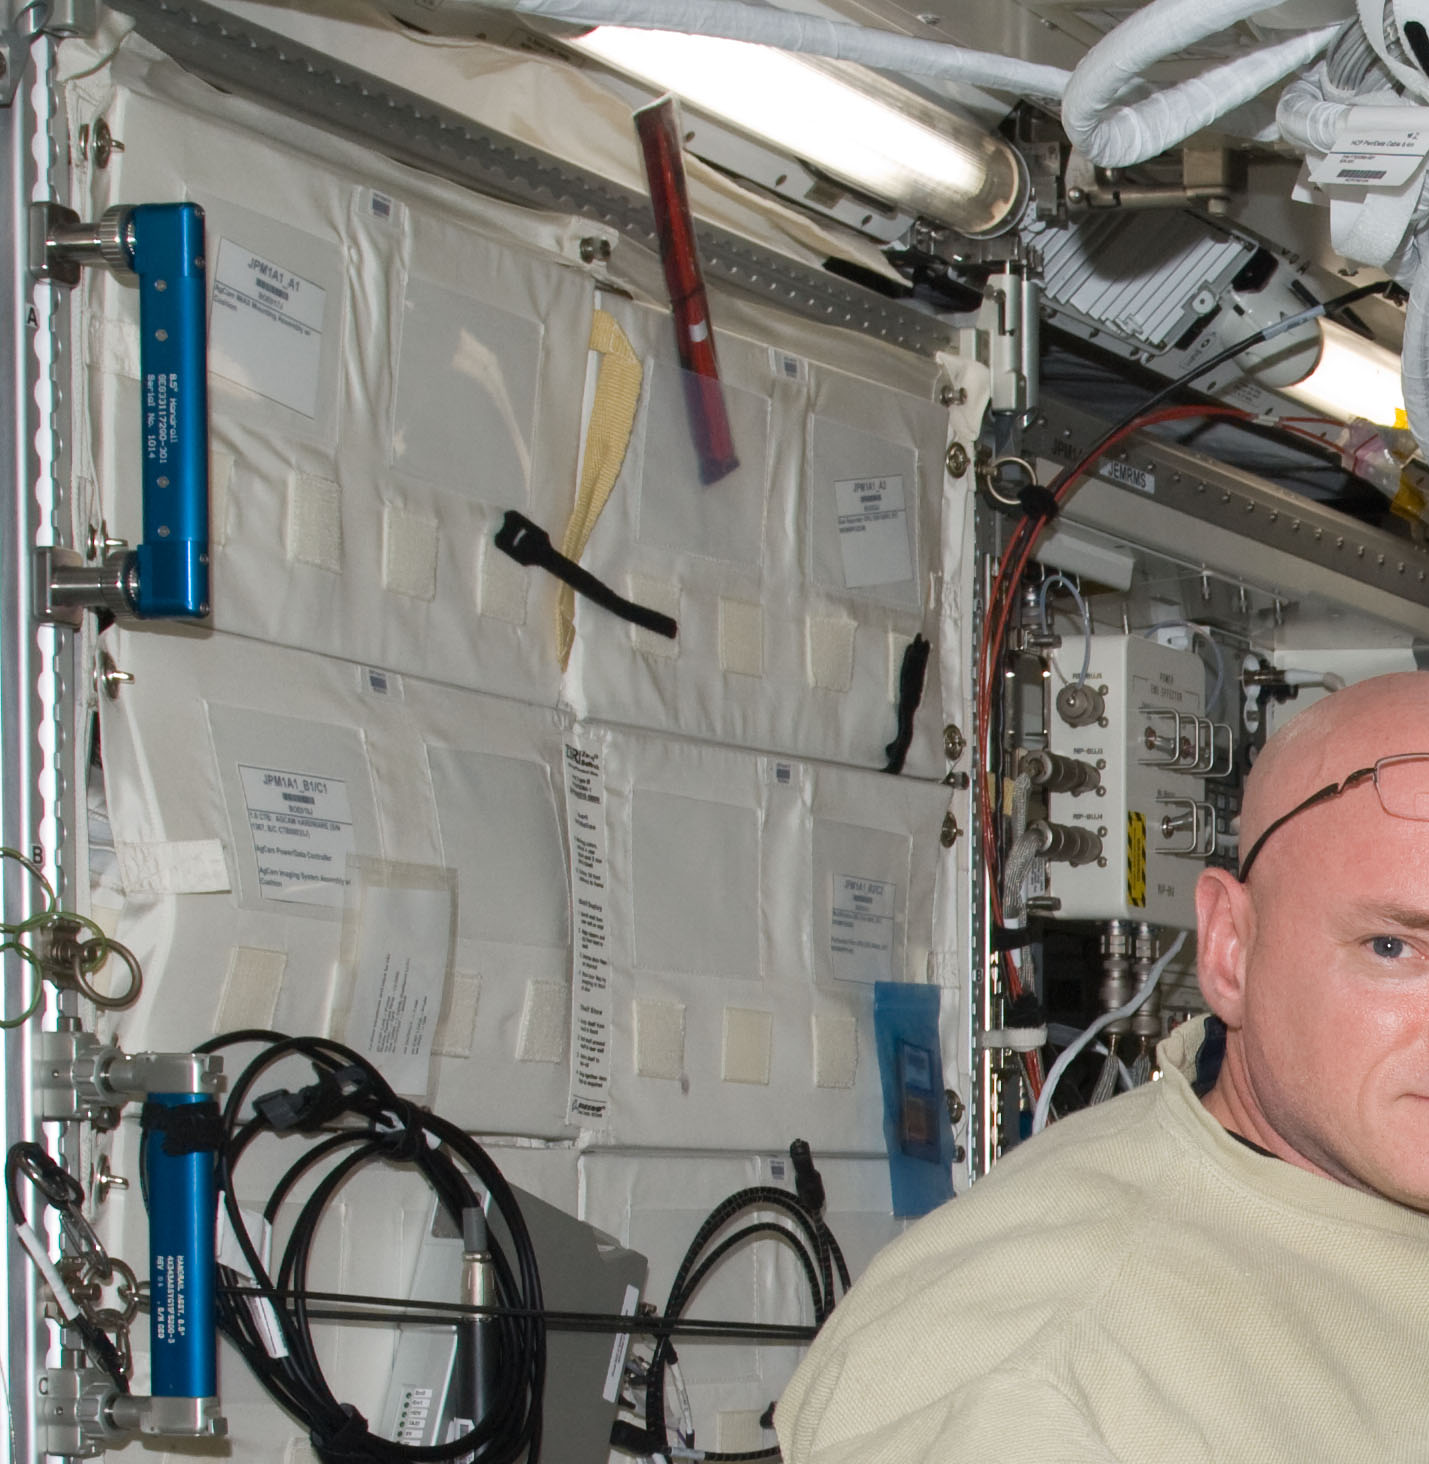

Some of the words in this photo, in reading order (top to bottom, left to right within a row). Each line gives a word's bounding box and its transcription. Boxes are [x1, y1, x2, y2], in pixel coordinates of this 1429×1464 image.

[248, 257, 300, 292] JPM1A1_A1
[28, 308, 38, 327] A
[147, 374, 156, 407] Serial
[1109, 461, 1146, 488] JEMRMS
[264, 774, 328, 794] JPM1A1_B1/C1
[33, 847, 43, 865] B
